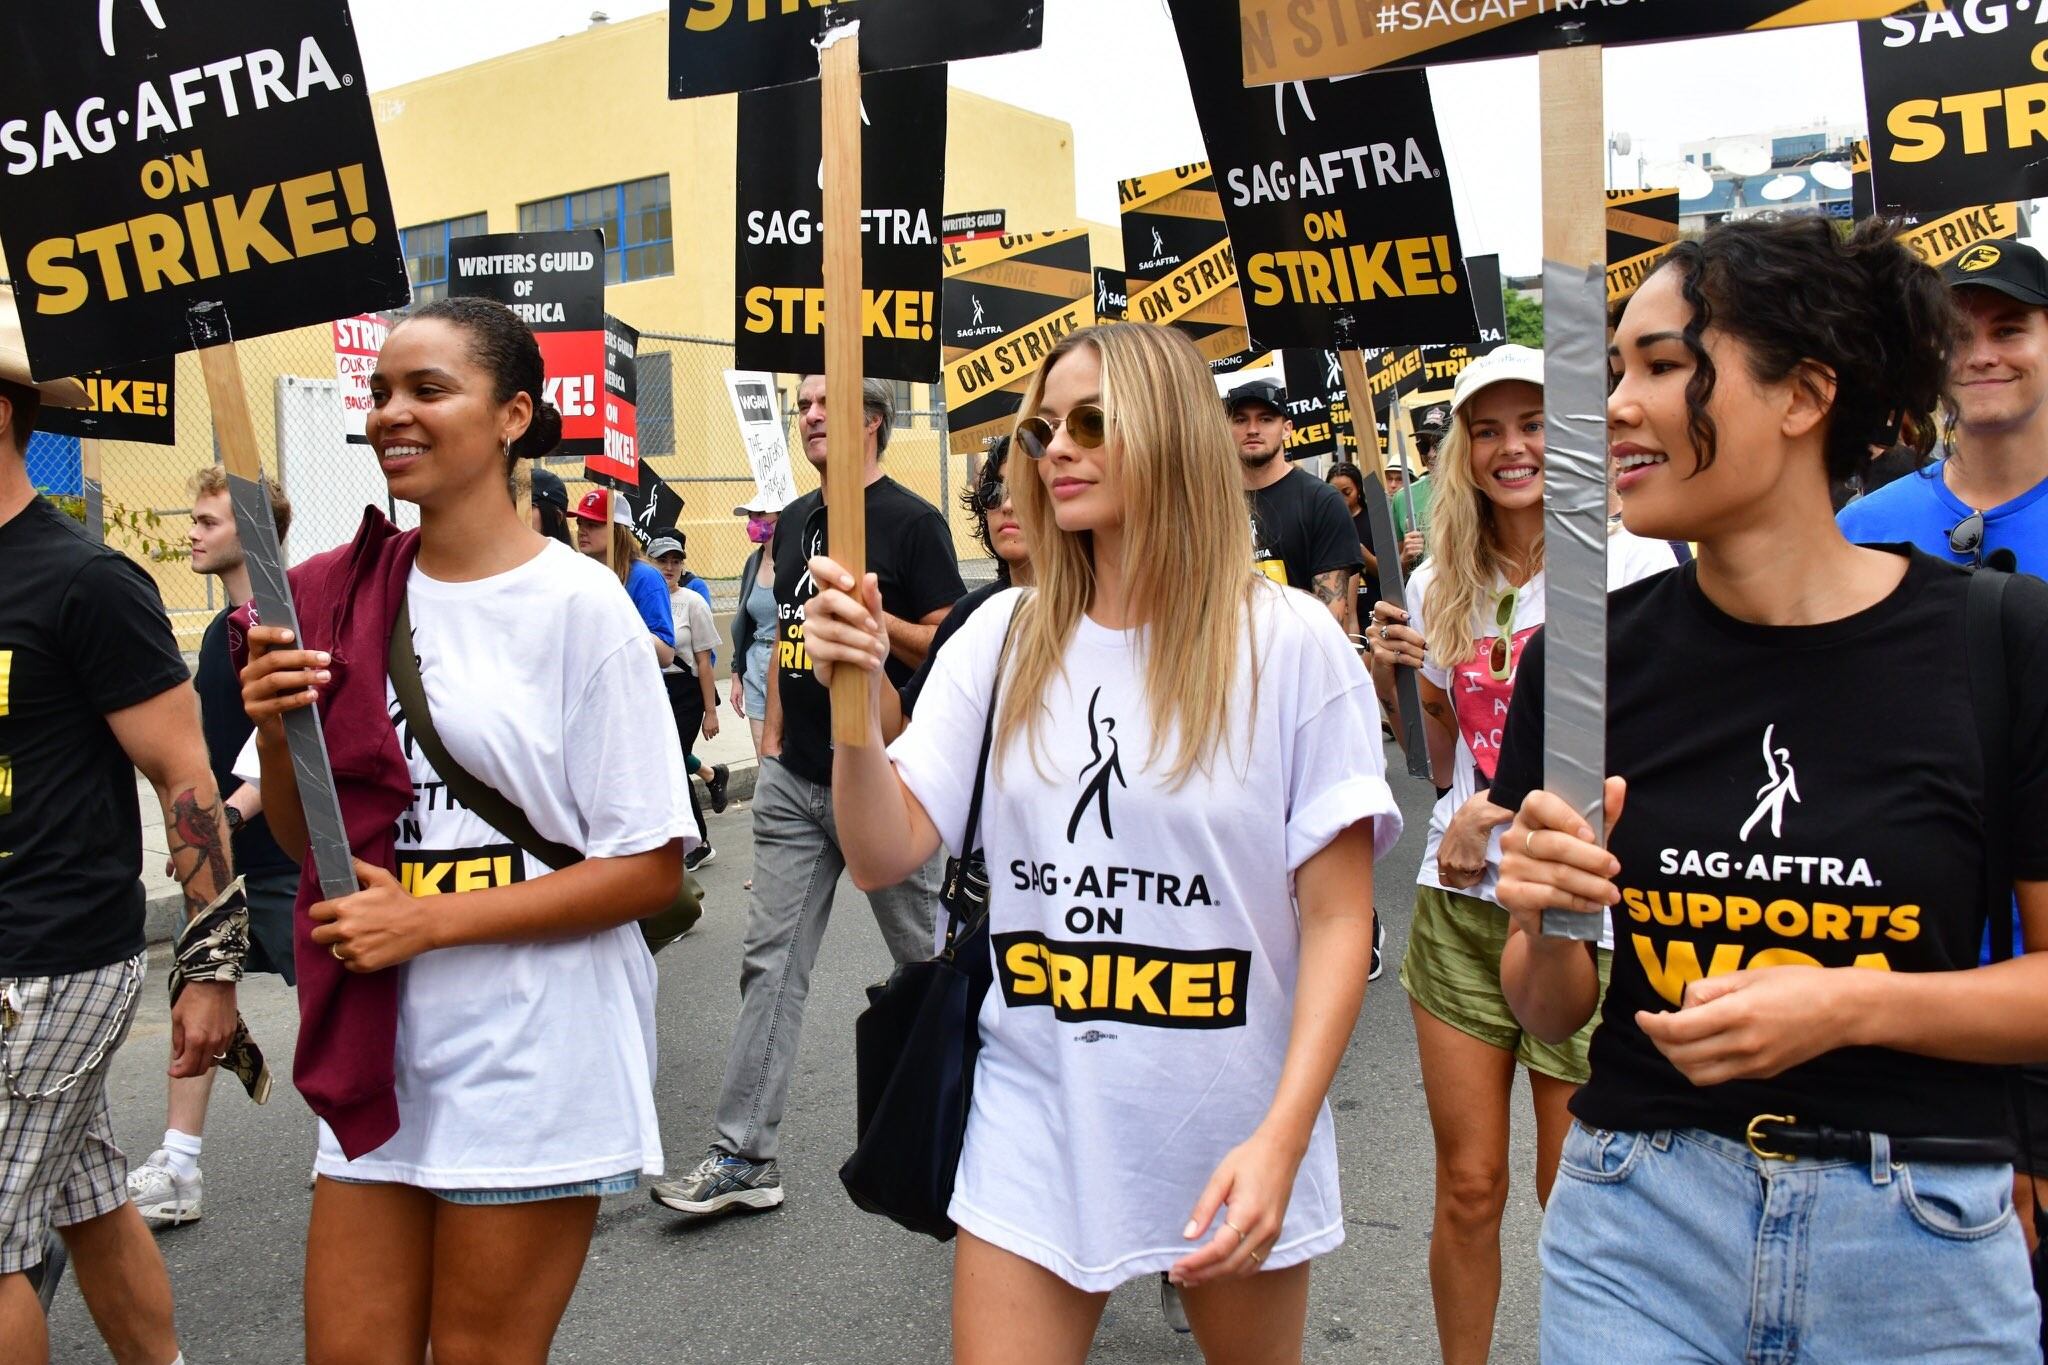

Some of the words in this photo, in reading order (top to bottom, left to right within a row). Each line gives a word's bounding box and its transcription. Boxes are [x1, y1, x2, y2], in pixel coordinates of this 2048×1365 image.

[1376, 0, 1646, 33] #SAGAF
[1881, 0, 2048, 48] SAG·
[1243, 10, 1277, 74] N
[1886, 83, 2048, 163] STR
[141, 148, 209, 200] ON
[747, 209, 932, 245] SAG·TRA
[943, 216, 976, 232] WRITERS
[977, 213, 1002, 227] GUILD
[1304, 210, 1347, 242] ON
[1908, 203, 2004, 261] STRIKE
[27, 163, 377, 315] STRIKE!
[458, 253, 536, 277] WRITERS
[540, 252, 594, 272] GUILD
[1247, 235, 1458, 307] STRIKE!
[1606, 253, 1663, 293] TRI
[513, 280, 533, 297] OF
[1139, 287, 1173, 322] ON
[1173, 244, 1236, 304] STRIK
[507, 303, 565, 323] ERICA
[744, 286, 934, 341] STRKE!
[1108, 292, 1127, 307] SAG
[1121, 310, 1128, 320] O
[604, 330, 617, 350] ERS
[617, 338, 634, 360] GUILD
[608, 352, 616, 367] OF
[1382, 351, 1395, 366] ON
[1449, 347, 1467, 358] ON
[957, 355, 994, 393] ON
[1208, 356, 1243, 368] STRONG
[1369, 348, 1422, 395] TRIKE!
[1425, 355, 1486, 380] STRI
[70, 375, 168, 417] IKE!
[542, 375, 595, 417] KE!
[605, 369, 626, 393] ERICA
[344, 396, 375, 410] BOUGH
[606, 403, 618, 425] ON
[604, 426, 634, 468] RIKE!
[1283, 422, 1332, 449] IKE!
[1472, 730, 1502, 750] AC
[401, 855, 511, 897] IKE!
[1065, 906, 1124, 935] ON
[1622, 887, 1921, 941] SUPPORTS
